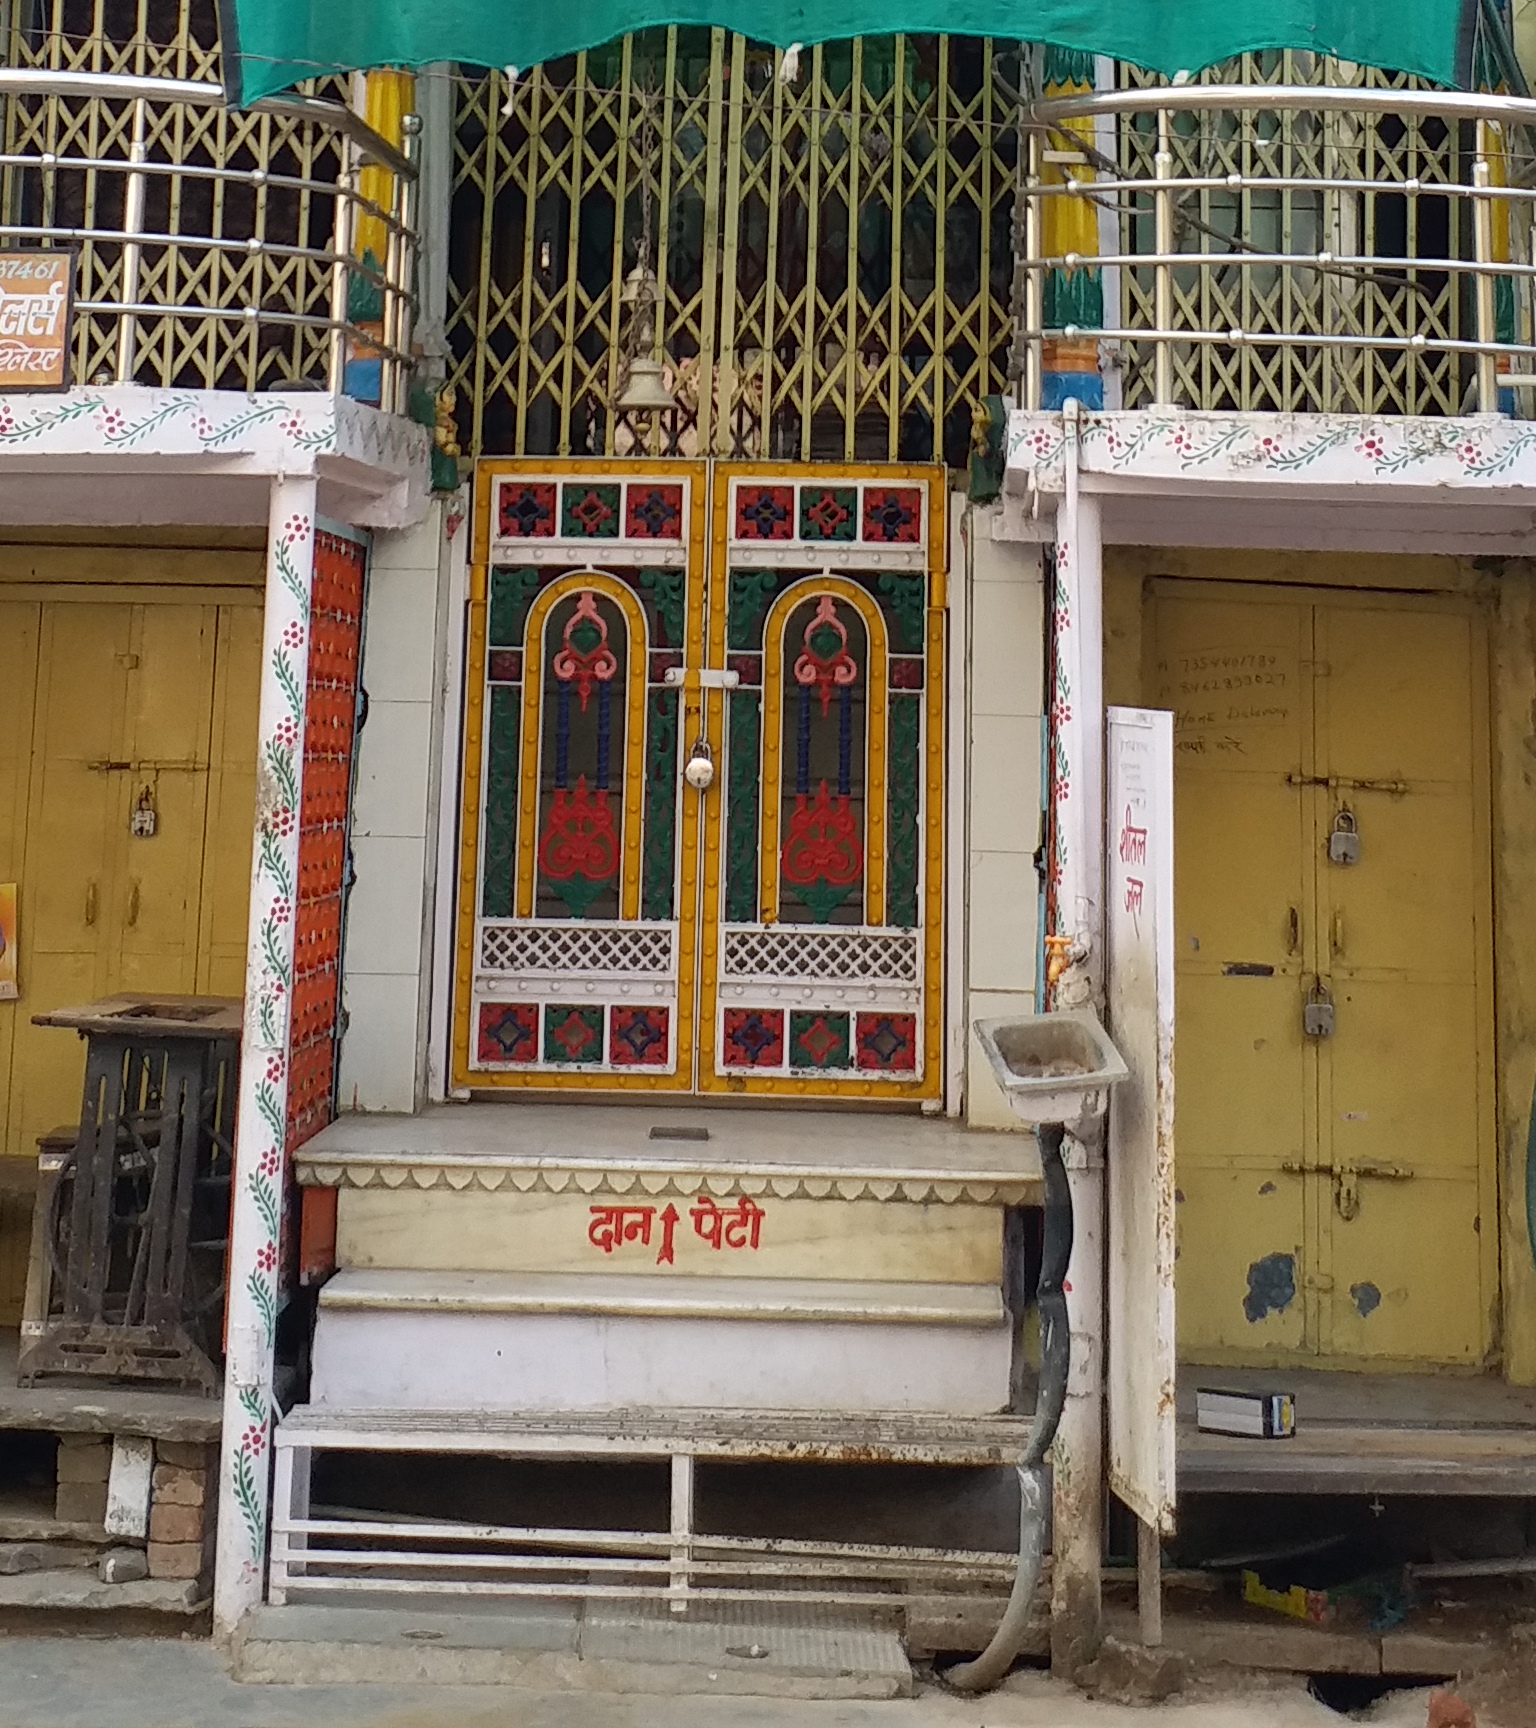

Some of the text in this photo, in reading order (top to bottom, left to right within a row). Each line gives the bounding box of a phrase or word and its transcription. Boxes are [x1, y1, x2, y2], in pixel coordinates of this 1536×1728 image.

[1119, 803, 1148, 865] शीतल
[1124, 877, 1144, 941] जल
[588, 1196, 766, 1253] दान पेटी
